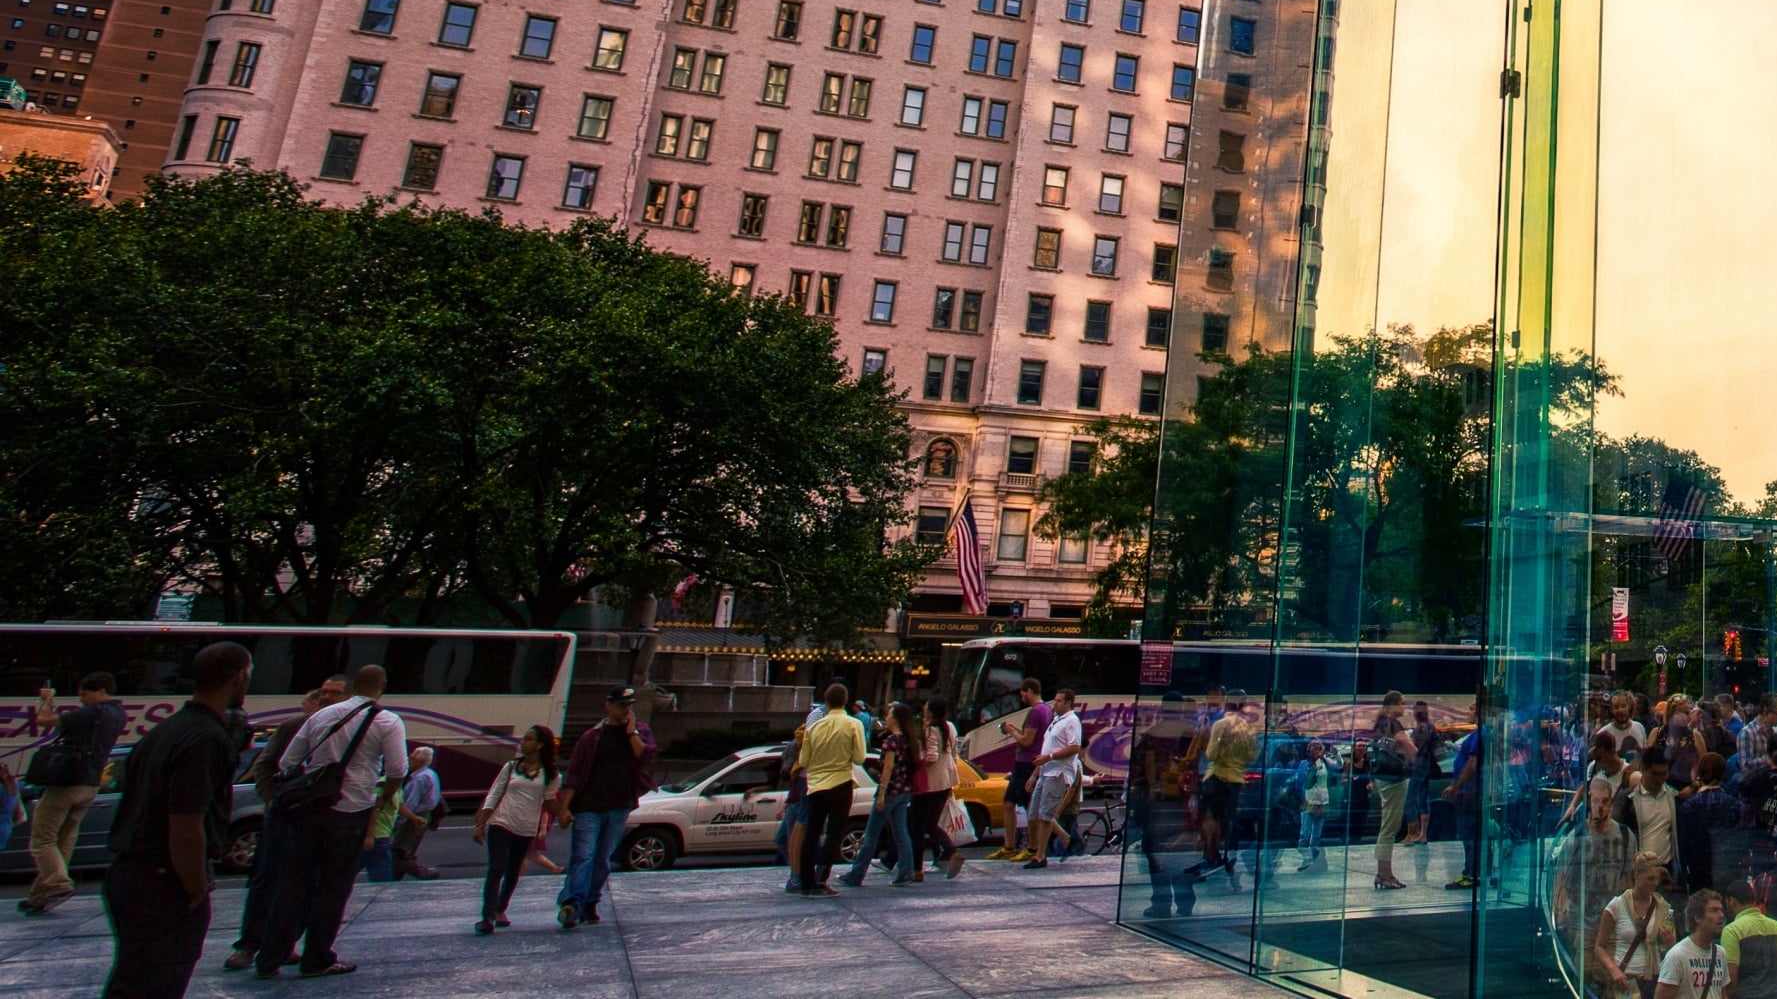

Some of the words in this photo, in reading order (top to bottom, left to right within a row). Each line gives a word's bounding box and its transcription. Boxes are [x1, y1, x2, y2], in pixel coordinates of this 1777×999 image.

[918, 623, 946, 631] ANGELO
[947, 623, 979, 631] GALASSO
[1051, 625, 1082, 634] GALASSO
[711, 812, 758, 824] Skyline
